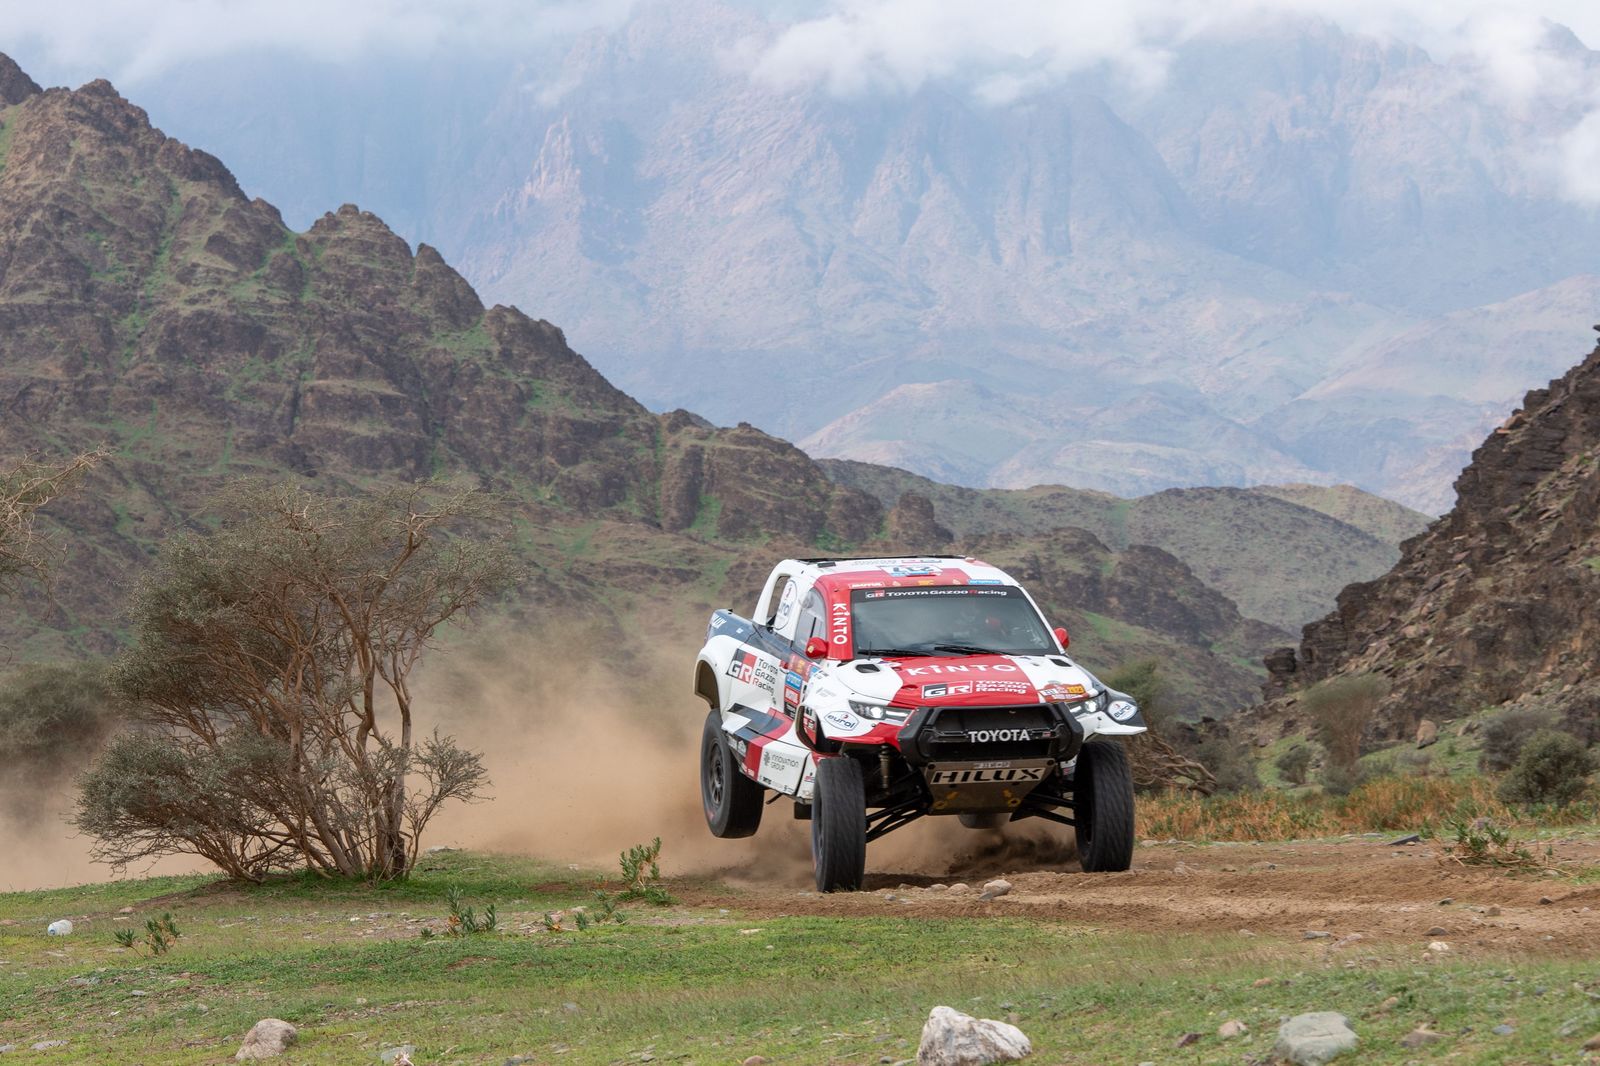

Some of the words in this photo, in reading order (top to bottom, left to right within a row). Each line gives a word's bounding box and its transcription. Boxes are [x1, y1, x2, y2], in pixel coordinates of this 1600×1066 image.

[969, 589, 1008, 597] Racing
[728, 659, 753, 683] GR
[923, 685, 972, 698] GR
[826, 713, 857, 730] eurol
[967, 729, 1031, 744] TOYOTA
[932, 768, 1042, 783] HILUX
